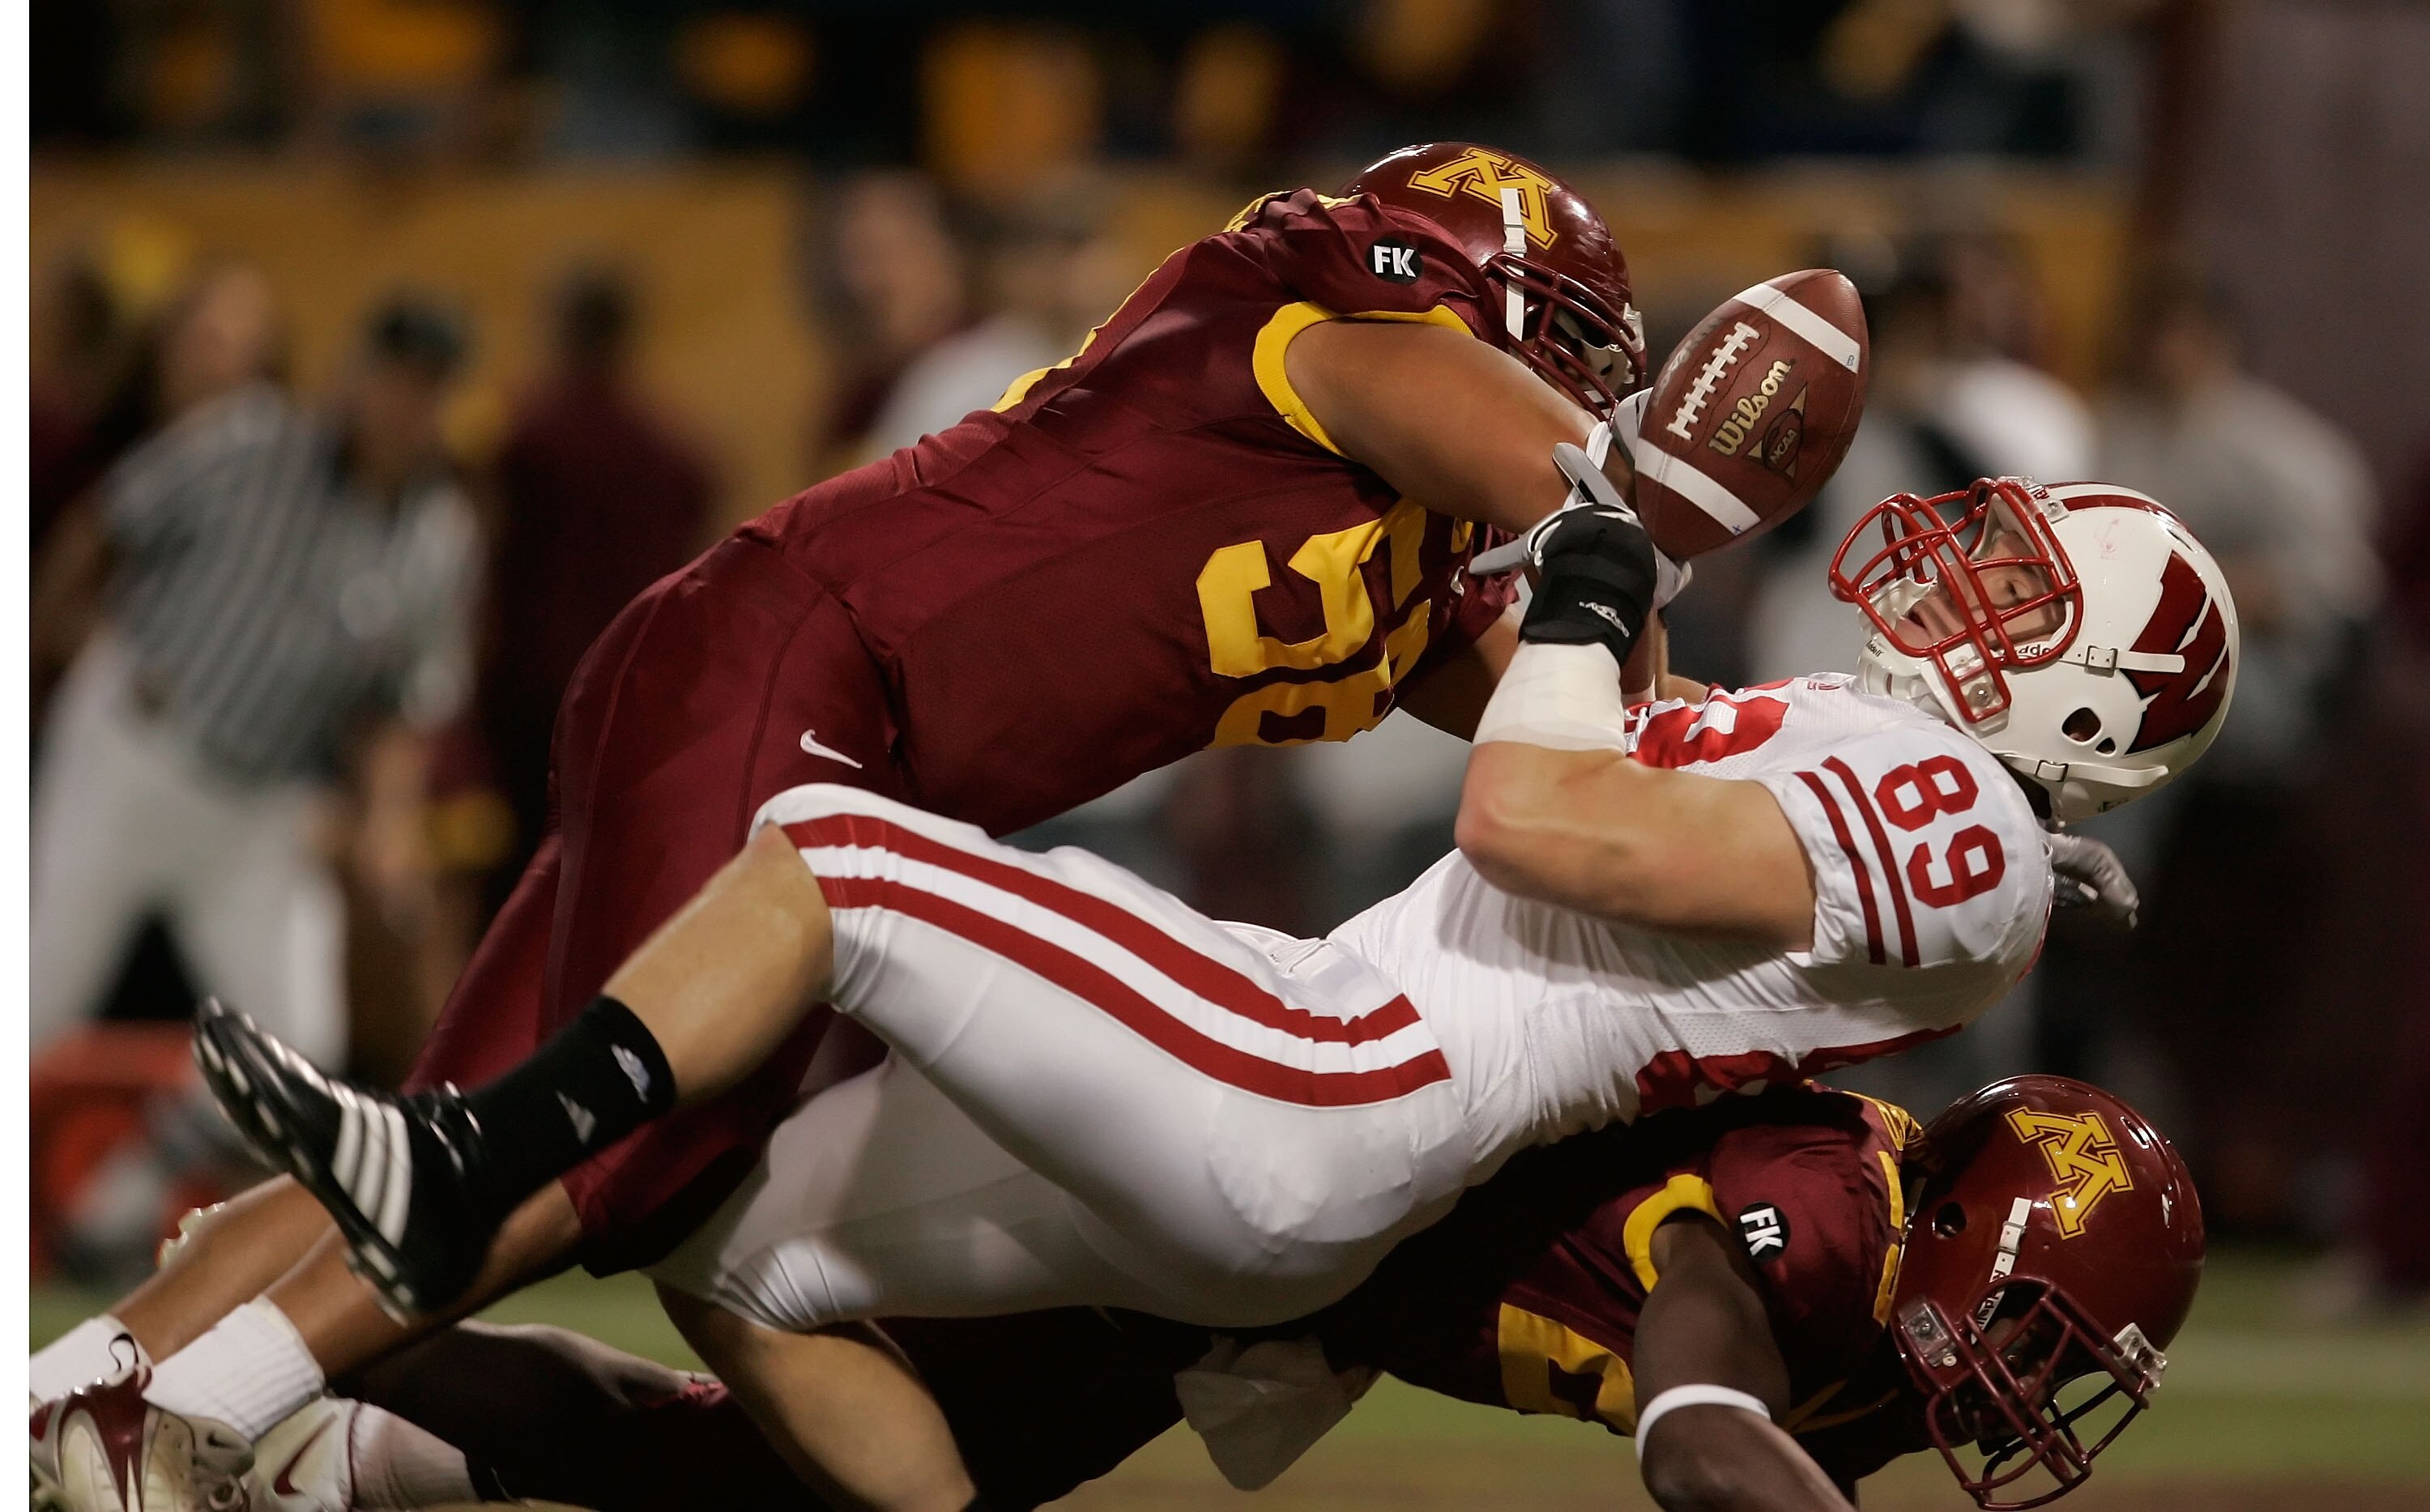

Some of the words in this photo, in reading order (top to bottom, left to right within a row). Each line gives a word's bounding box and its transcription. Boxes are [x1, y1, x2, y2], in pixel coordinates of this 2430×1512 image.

[1374, 245, 1417, 278] FK
[1708, 360, 1793, 456] Wilson
[1769, 429, 1797, 465] NCAA
[1874, 754, 2006, 909] 89
[1738, 1204, 1784, 1257] FK
